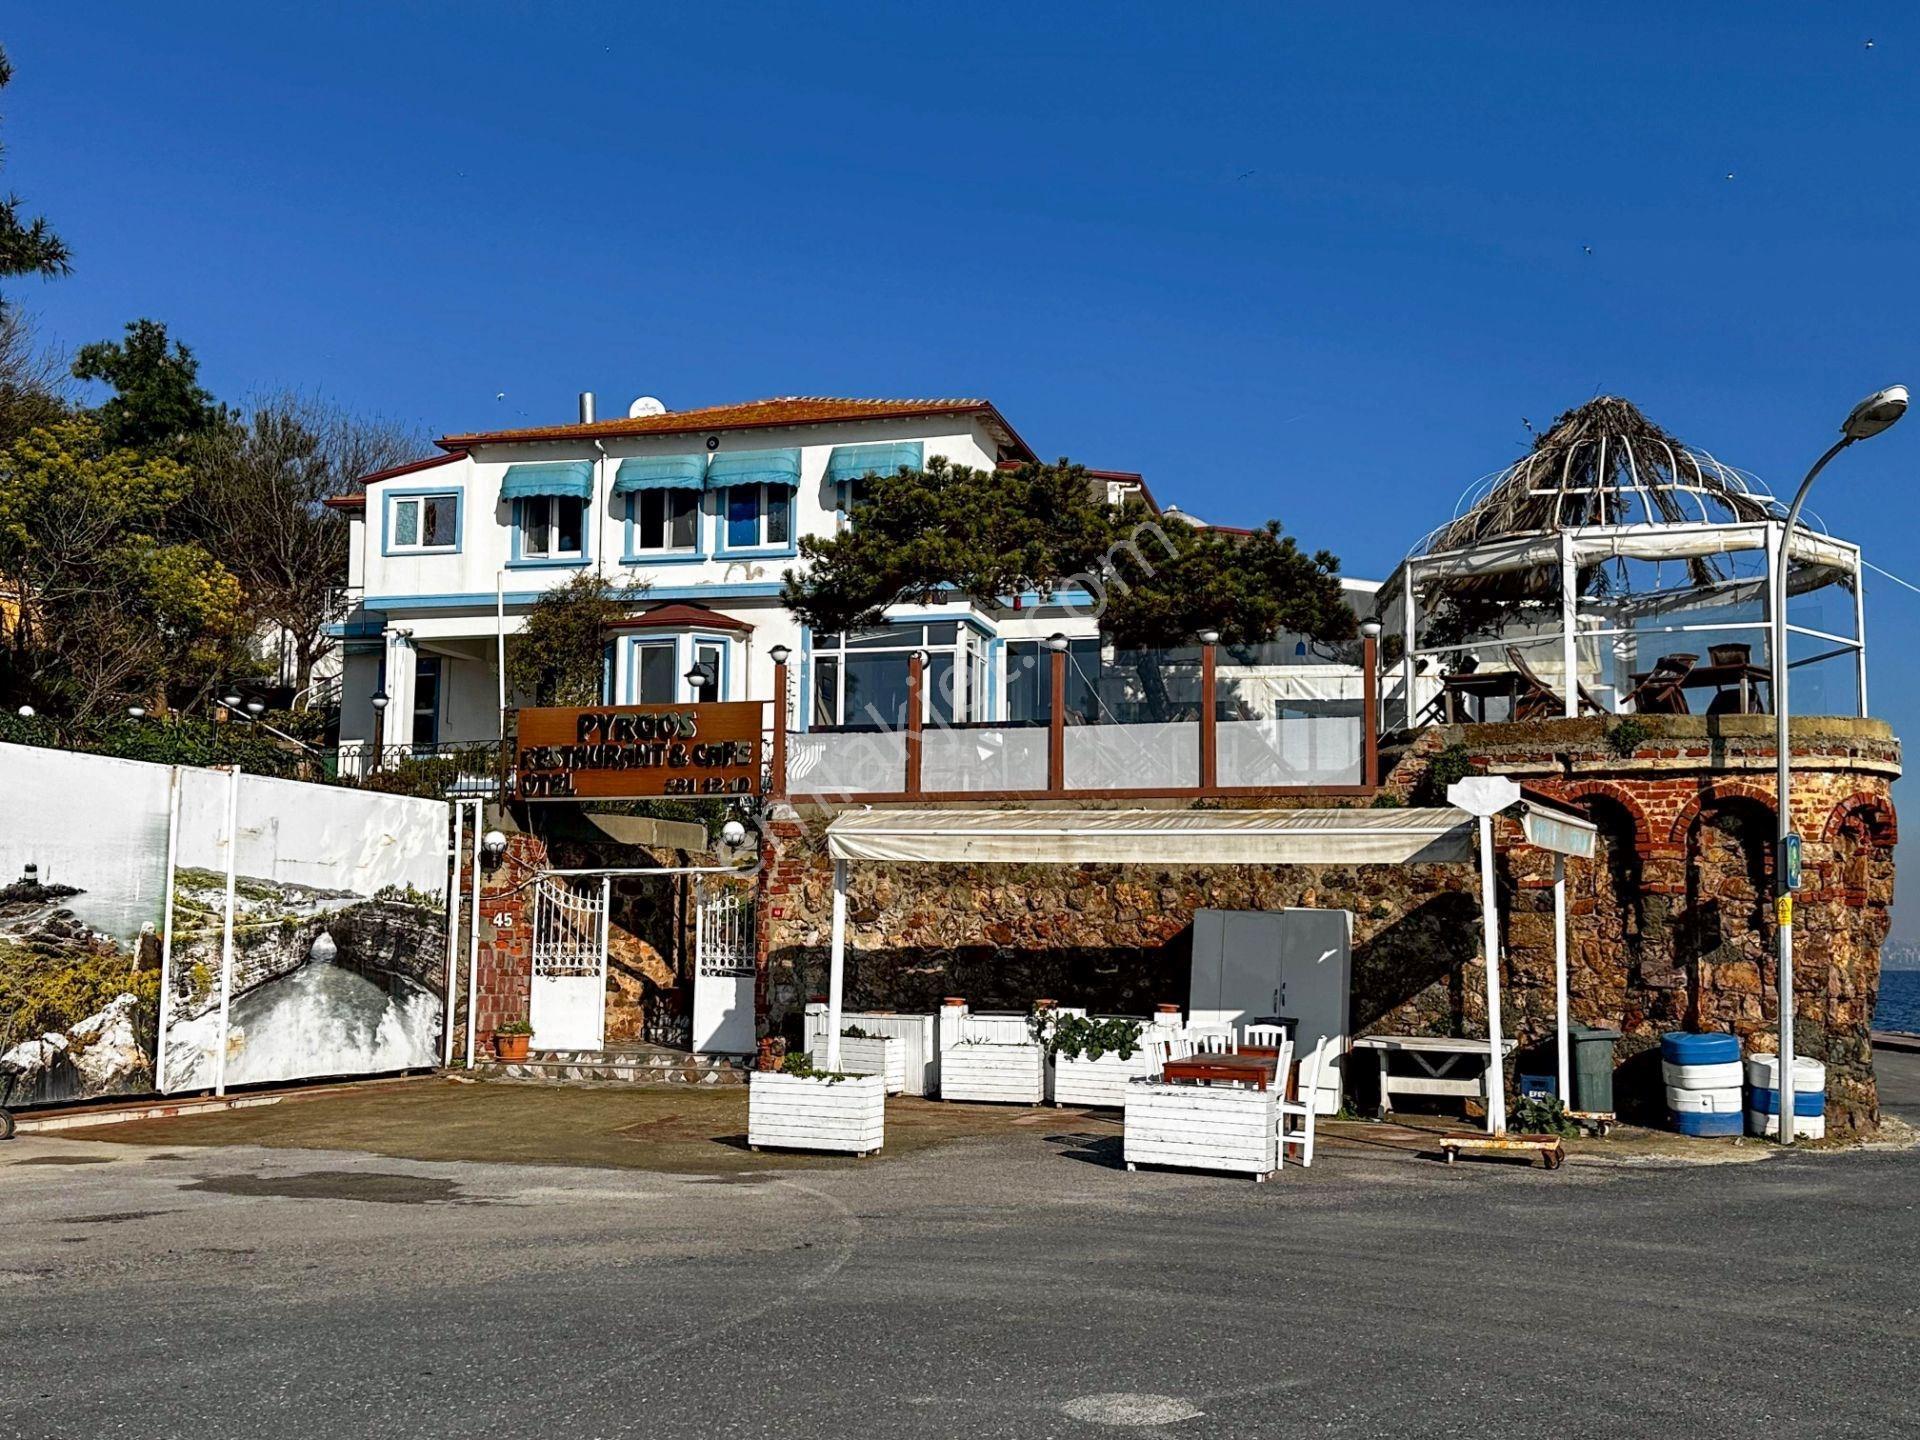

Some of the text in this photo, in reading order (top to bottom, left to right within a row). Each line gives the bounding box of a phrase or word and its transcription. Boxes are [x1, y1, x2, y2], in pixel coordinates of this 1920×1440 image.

[576, 711, 698, 741] PYRGOS
[519, 743, 666, 771] RESTAURANT
[692, 741, 752, 767] CAFE
[519, 772, 577, 797] OTEL
[492, 912, 513, 927] 45
